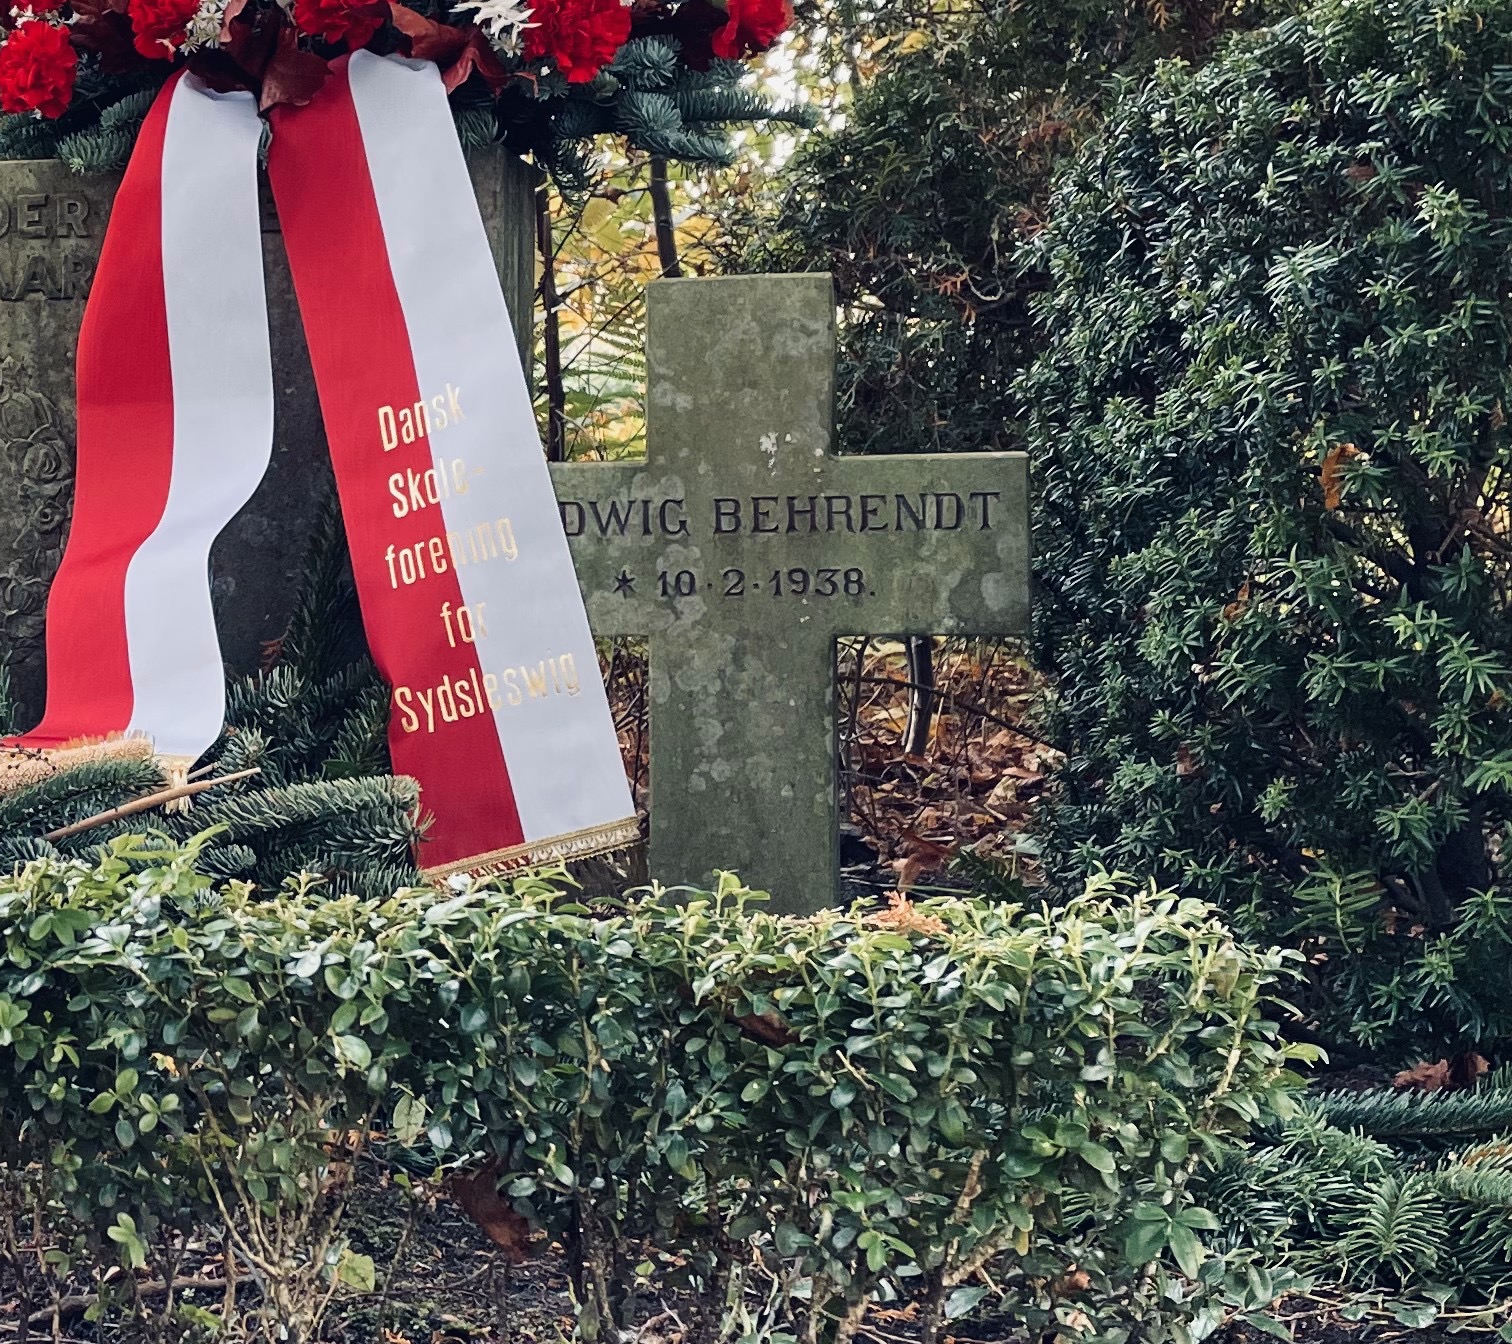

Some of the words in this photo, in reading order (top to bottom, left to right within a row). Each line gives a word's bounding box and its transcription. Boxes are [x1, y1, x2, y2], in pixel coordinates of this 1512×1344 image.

[378, 383, 466, 452] Dansk
[388, 458, 485, 518] Skole-
[558, 500, 691, 537] DWIG
[713, 491, 1001, 535] BEHRENDT
[385, 517, 518, 589] forening
[440, 601, 487, 648] for
[395, 648, 580, 733] Sydsleswig
